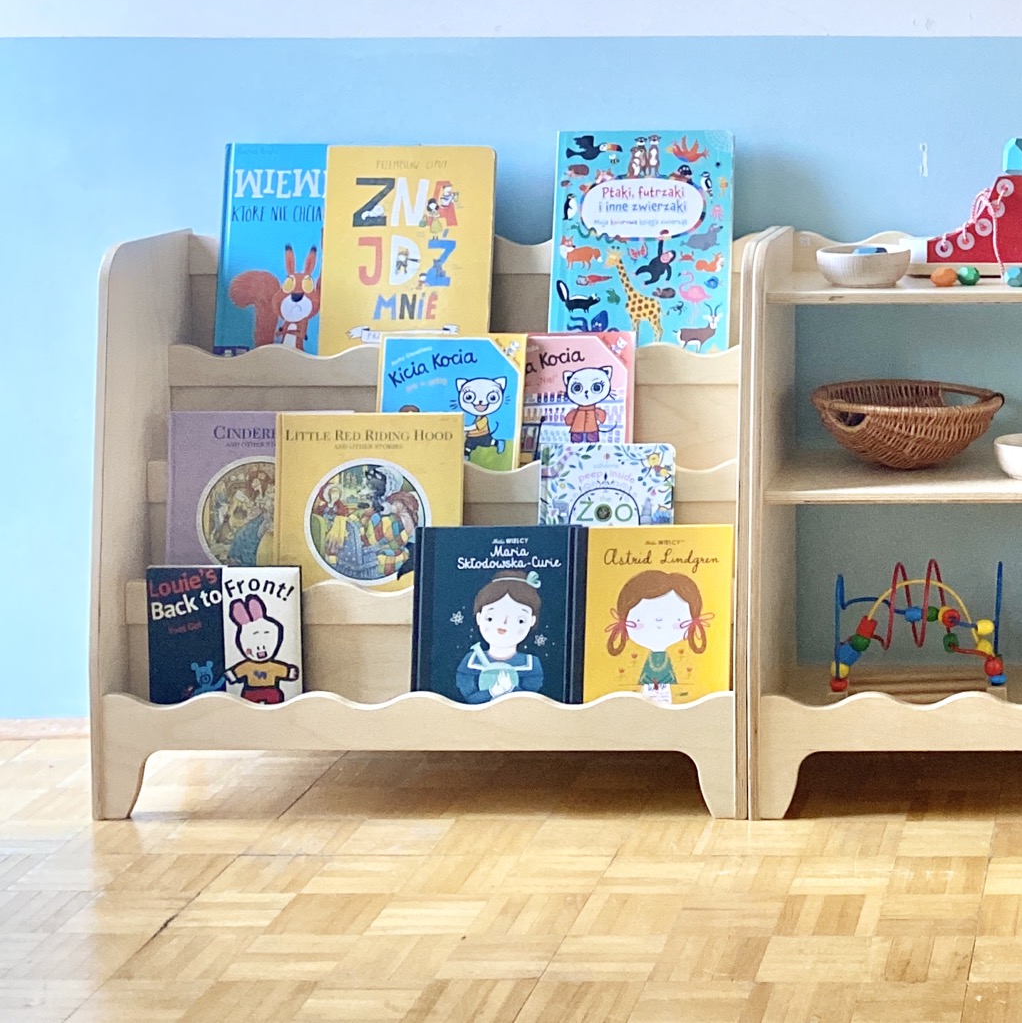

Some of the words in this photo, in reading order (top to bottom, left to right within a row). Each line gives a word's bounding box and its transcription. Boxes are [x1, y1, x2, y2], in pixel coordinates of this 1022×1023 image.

[352, 177, 458, 227] ZNA
[602, 185, 634, 200] Ptaki,
[638, 185, 685, 200] futrzaki
[271, 204, 287, 222] NIE
[293, 204, 323, 222] CHCIA
[605, 201, 628, 212] inne
[632, 201, 687, 213] zwierzaki
[388, 362, 429, 388] Kicia
[432, 349, 478, 372] Kocia
[539, 348, 585, 370] Kocia
[285, 429, 331, 441] LITTLE
[335, 429, 361, 441] RED
[365, 429, 410, 441] RIDING
[414, 429, 454, 441] HOOD
[490, 545, 530, 558] Maria
[603, 548, 652, 565] Astrid
[660, 547, 720, 574] Lindgren
[457, 556, 562, 569] Skłodowska-Curie
[148, 569, 218, 598] Louie's
[151, 593, 199, 621] Back
[200, 589, 223, 608] to
[224, 578, 295, 602] Front!
